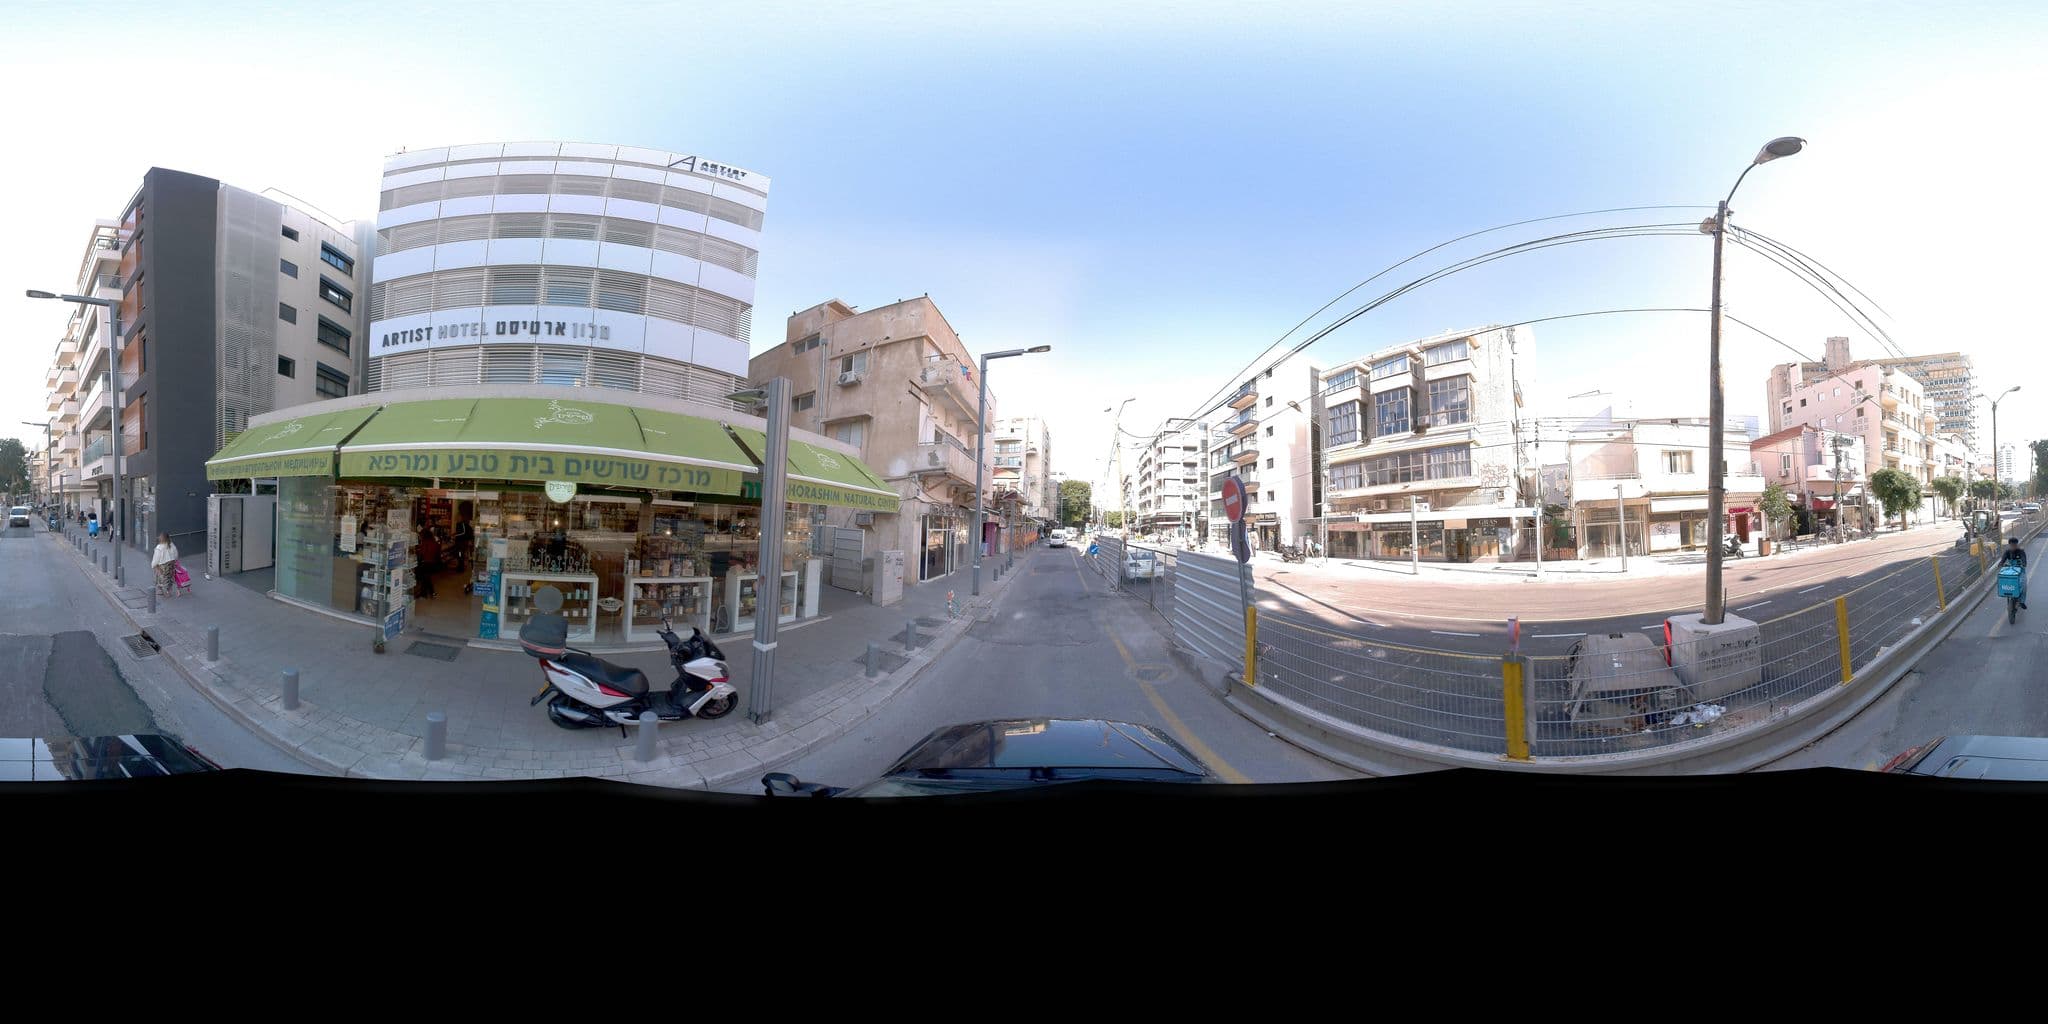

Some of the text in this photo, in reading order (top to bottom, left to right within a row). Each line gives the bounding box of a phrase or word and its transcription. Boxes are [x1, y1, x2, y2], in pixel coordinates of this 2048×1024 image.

[701, 162, 747, 177] ARTIST
[382, 322, 489, 348] ARTIST HOTEL
[495, 321, 610, 340] מלון ארטיסט
[368, 454, 711, 486] מרכז שרשים בית טבע ומרפא
[844, 493, 876, 506] NATURAL
